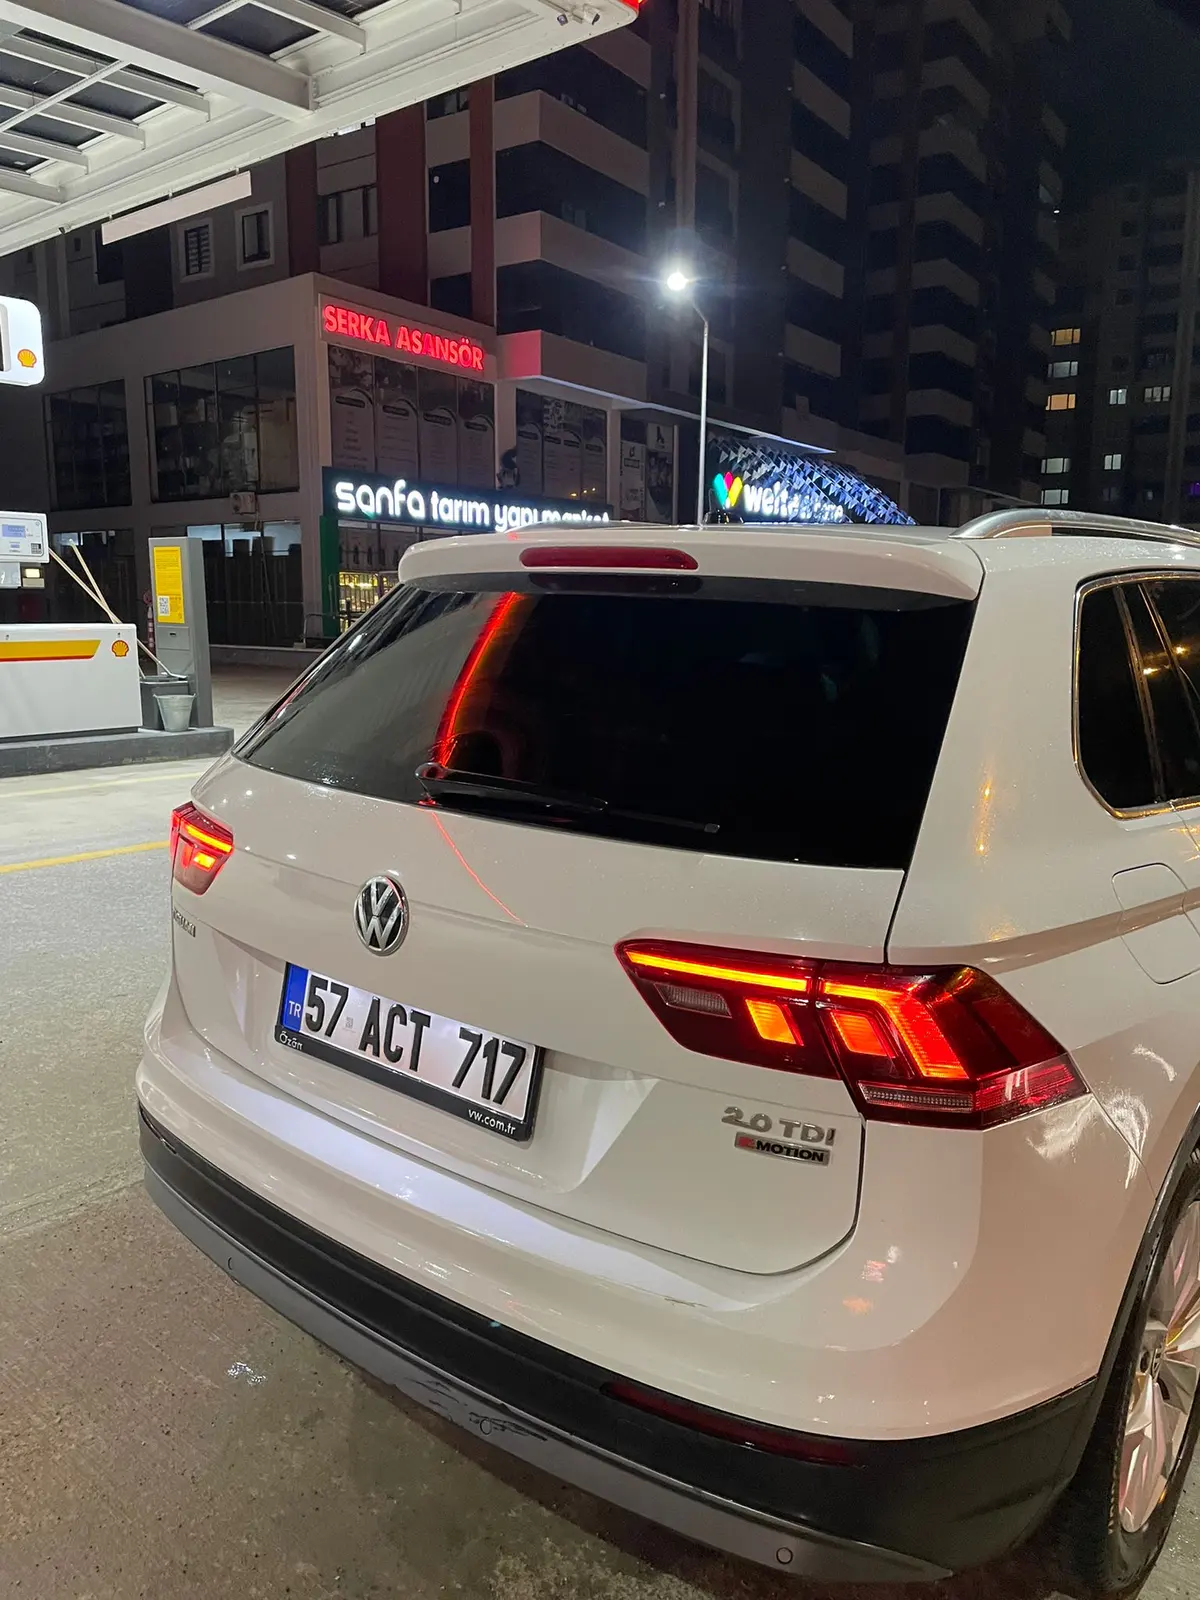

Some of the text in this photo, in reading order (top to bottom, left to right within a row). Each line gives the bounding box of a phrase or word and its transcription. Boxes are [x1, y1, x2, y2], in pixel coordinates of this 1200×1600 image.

[323, 305, 484, 371] SERKA ASANSÖR
[335, 479, 426, 520] sanfa
[430, 490, 490, 526] tarım
[288, 1000, 302, 1018] TR
[305, 974, 527, 1105] 57 ACT 717
[468, 1108, 516, 1135] vw.com.tr
[721, 1106, 837, 1146] 2.0 TDI
